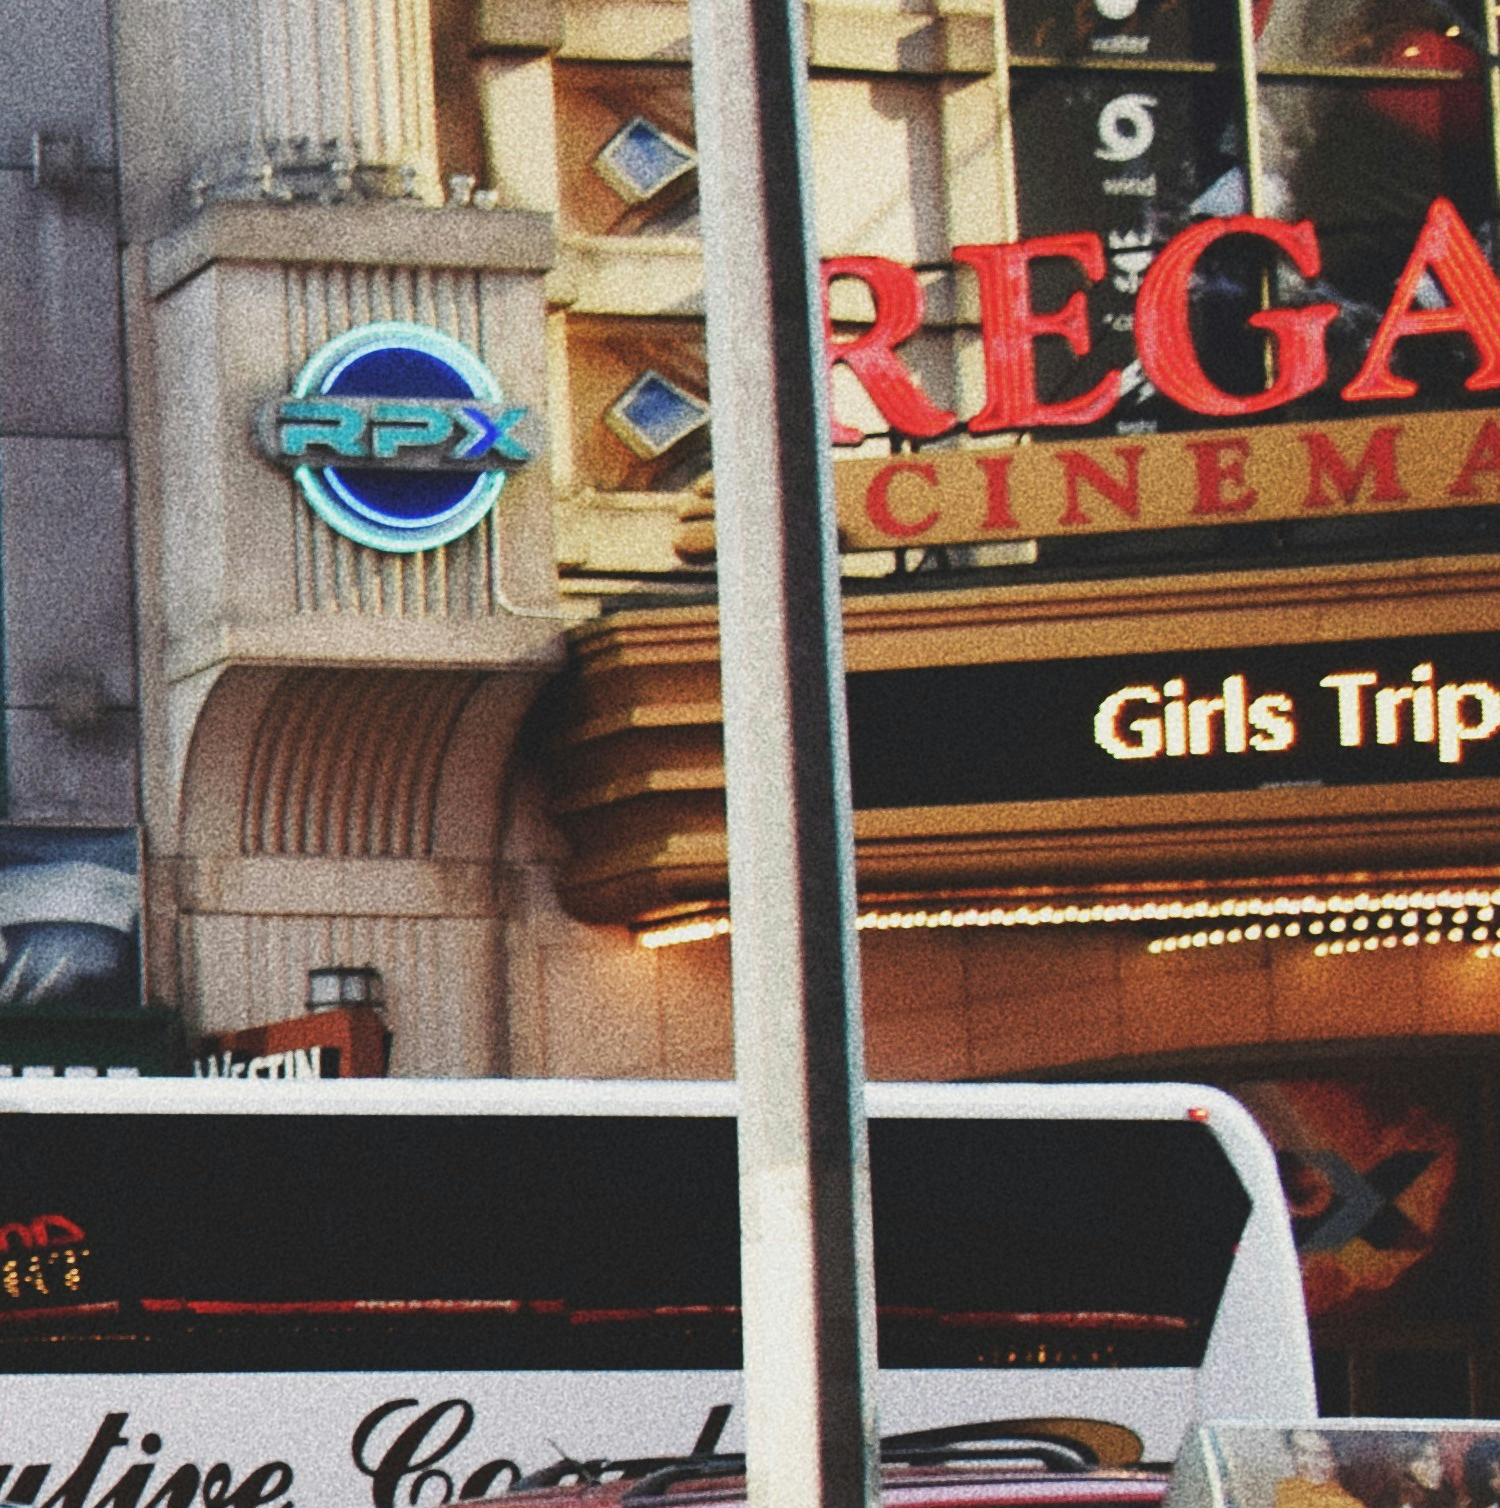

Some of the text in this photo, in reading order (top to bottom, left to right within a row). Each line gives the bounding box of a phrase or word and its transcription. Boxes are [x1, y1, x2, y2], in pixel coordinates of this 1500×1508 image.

[278, 402, 532, 462] RPX
[1093, 661, 1500, 764] Girls Trip
